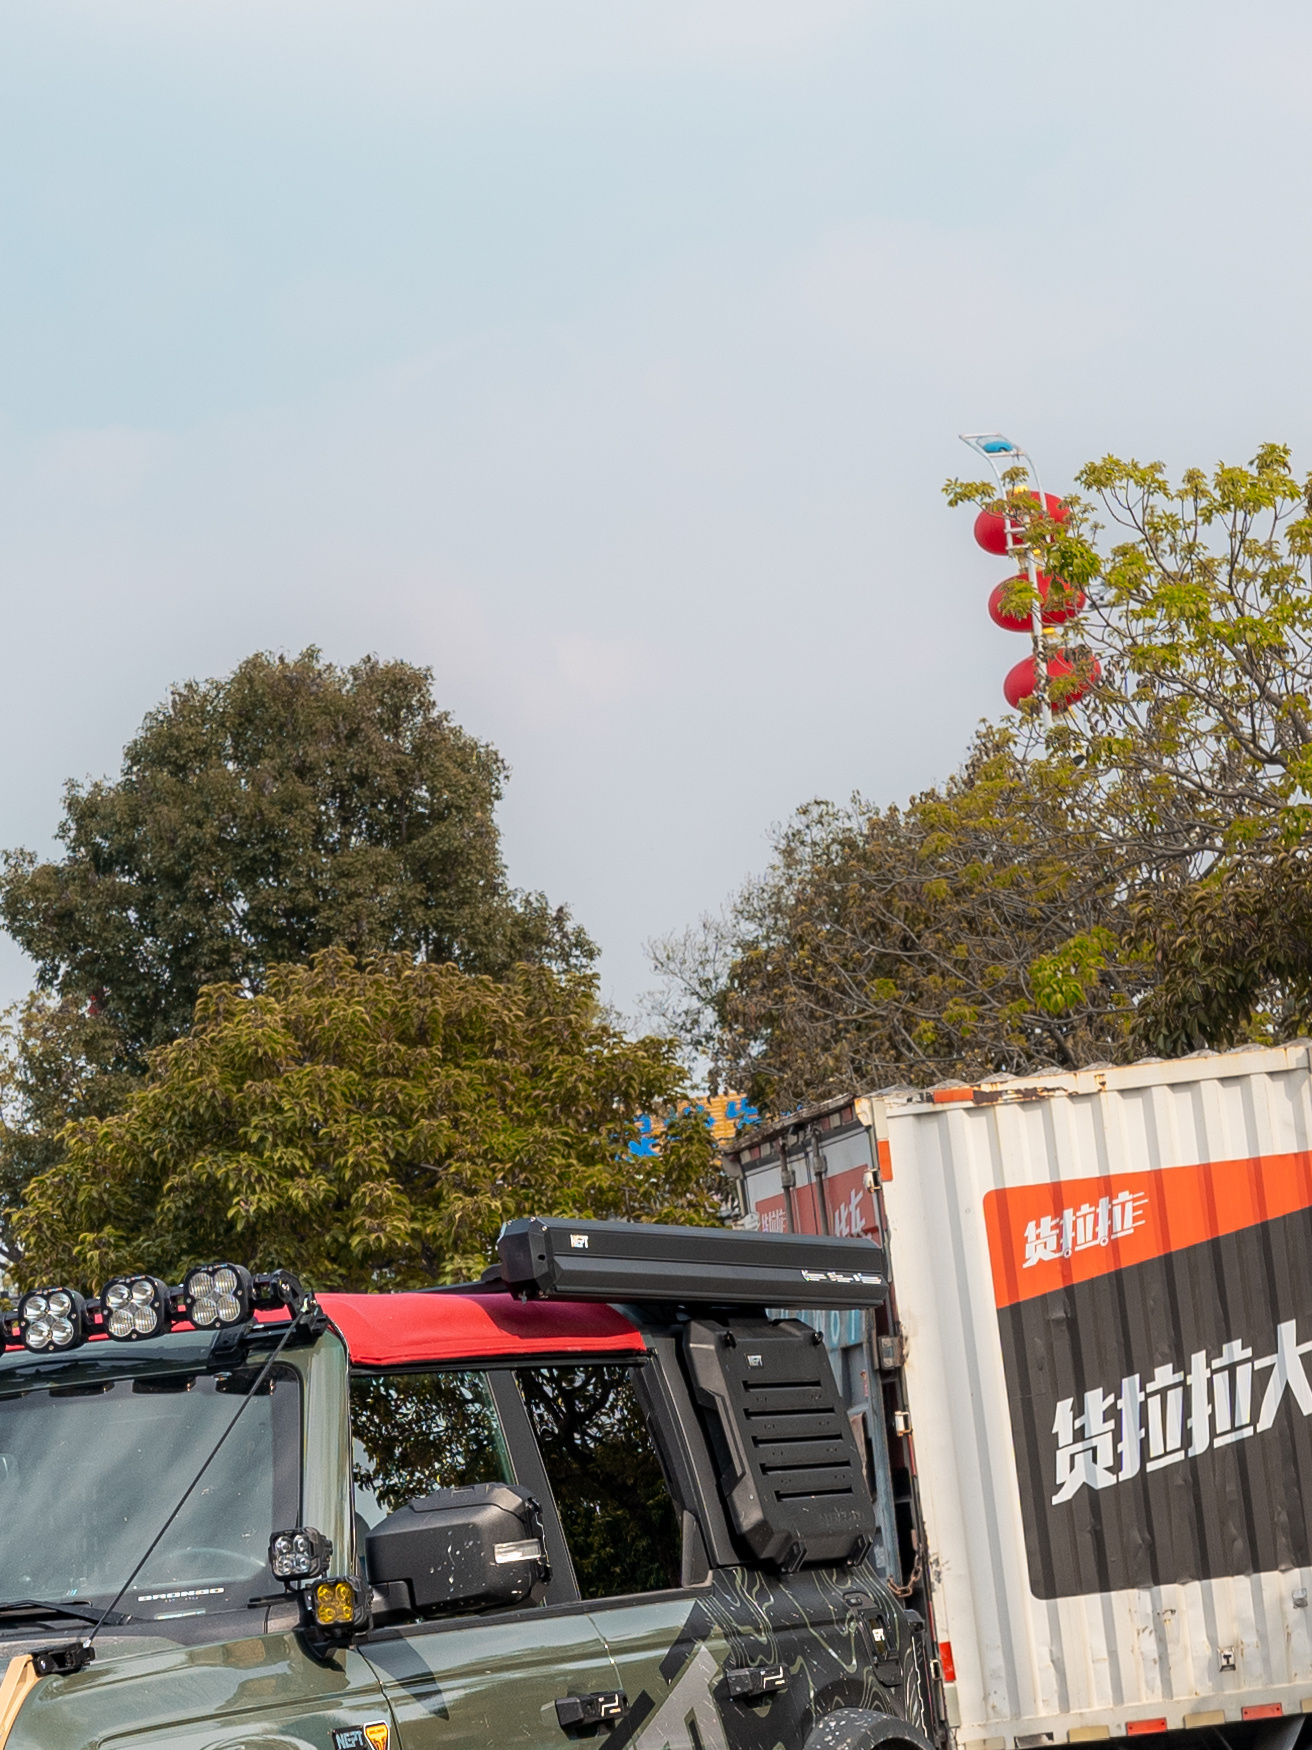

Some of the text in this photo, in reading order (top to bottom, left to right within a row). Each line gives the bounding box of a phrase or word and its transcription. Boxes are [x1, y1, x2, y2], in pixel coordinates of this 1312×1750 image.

[1023, 1190, 1148, 1268] 货拉拉
[1052, 1318, 1312, 1506] 货拉拉大
[335, 1730, 364, 1750] NEPT
